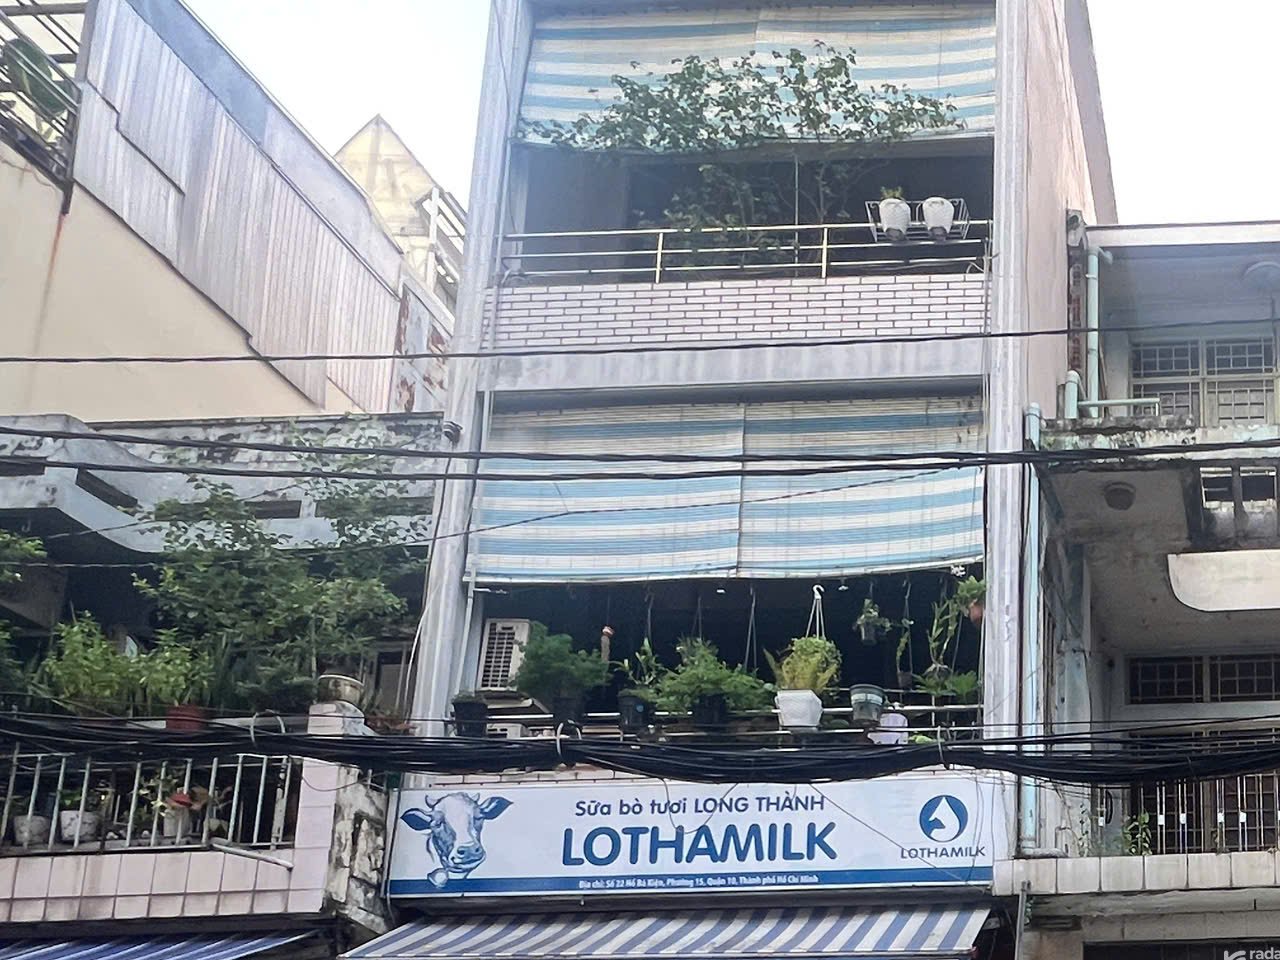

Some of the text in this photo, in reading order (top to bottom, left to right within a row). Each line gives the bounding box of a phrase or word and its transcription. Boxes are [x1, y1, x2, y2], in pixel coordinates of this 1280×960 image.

[575, 791, 825, 816] Sữa bò tươi LONG THÀNH
[562, 821, 838, 866] LOTHAMILK
[901, 846, 986, 860] LOTHAMILK
